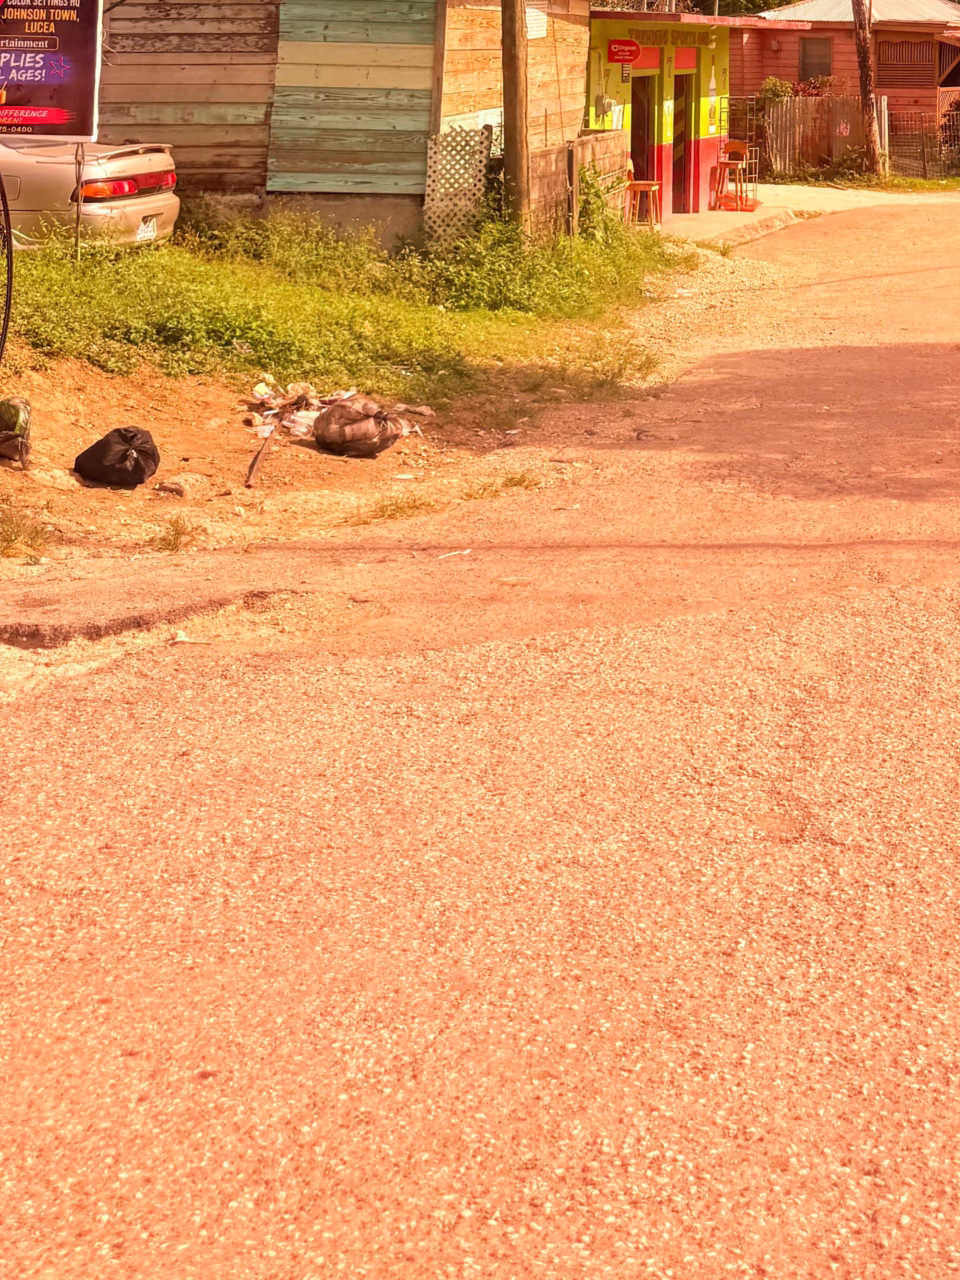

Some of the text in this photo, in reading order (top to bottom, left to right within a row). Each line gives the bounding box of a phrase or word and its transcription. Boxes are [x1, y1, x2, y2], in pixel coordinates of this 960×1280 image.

[1, 8, 79, 22] JOHNSON TOWN,
[25, 22, 55, 33] LUCEA
[0, 53, 44, 67] PLIES
[9, 69, 46, 81] AGES!
